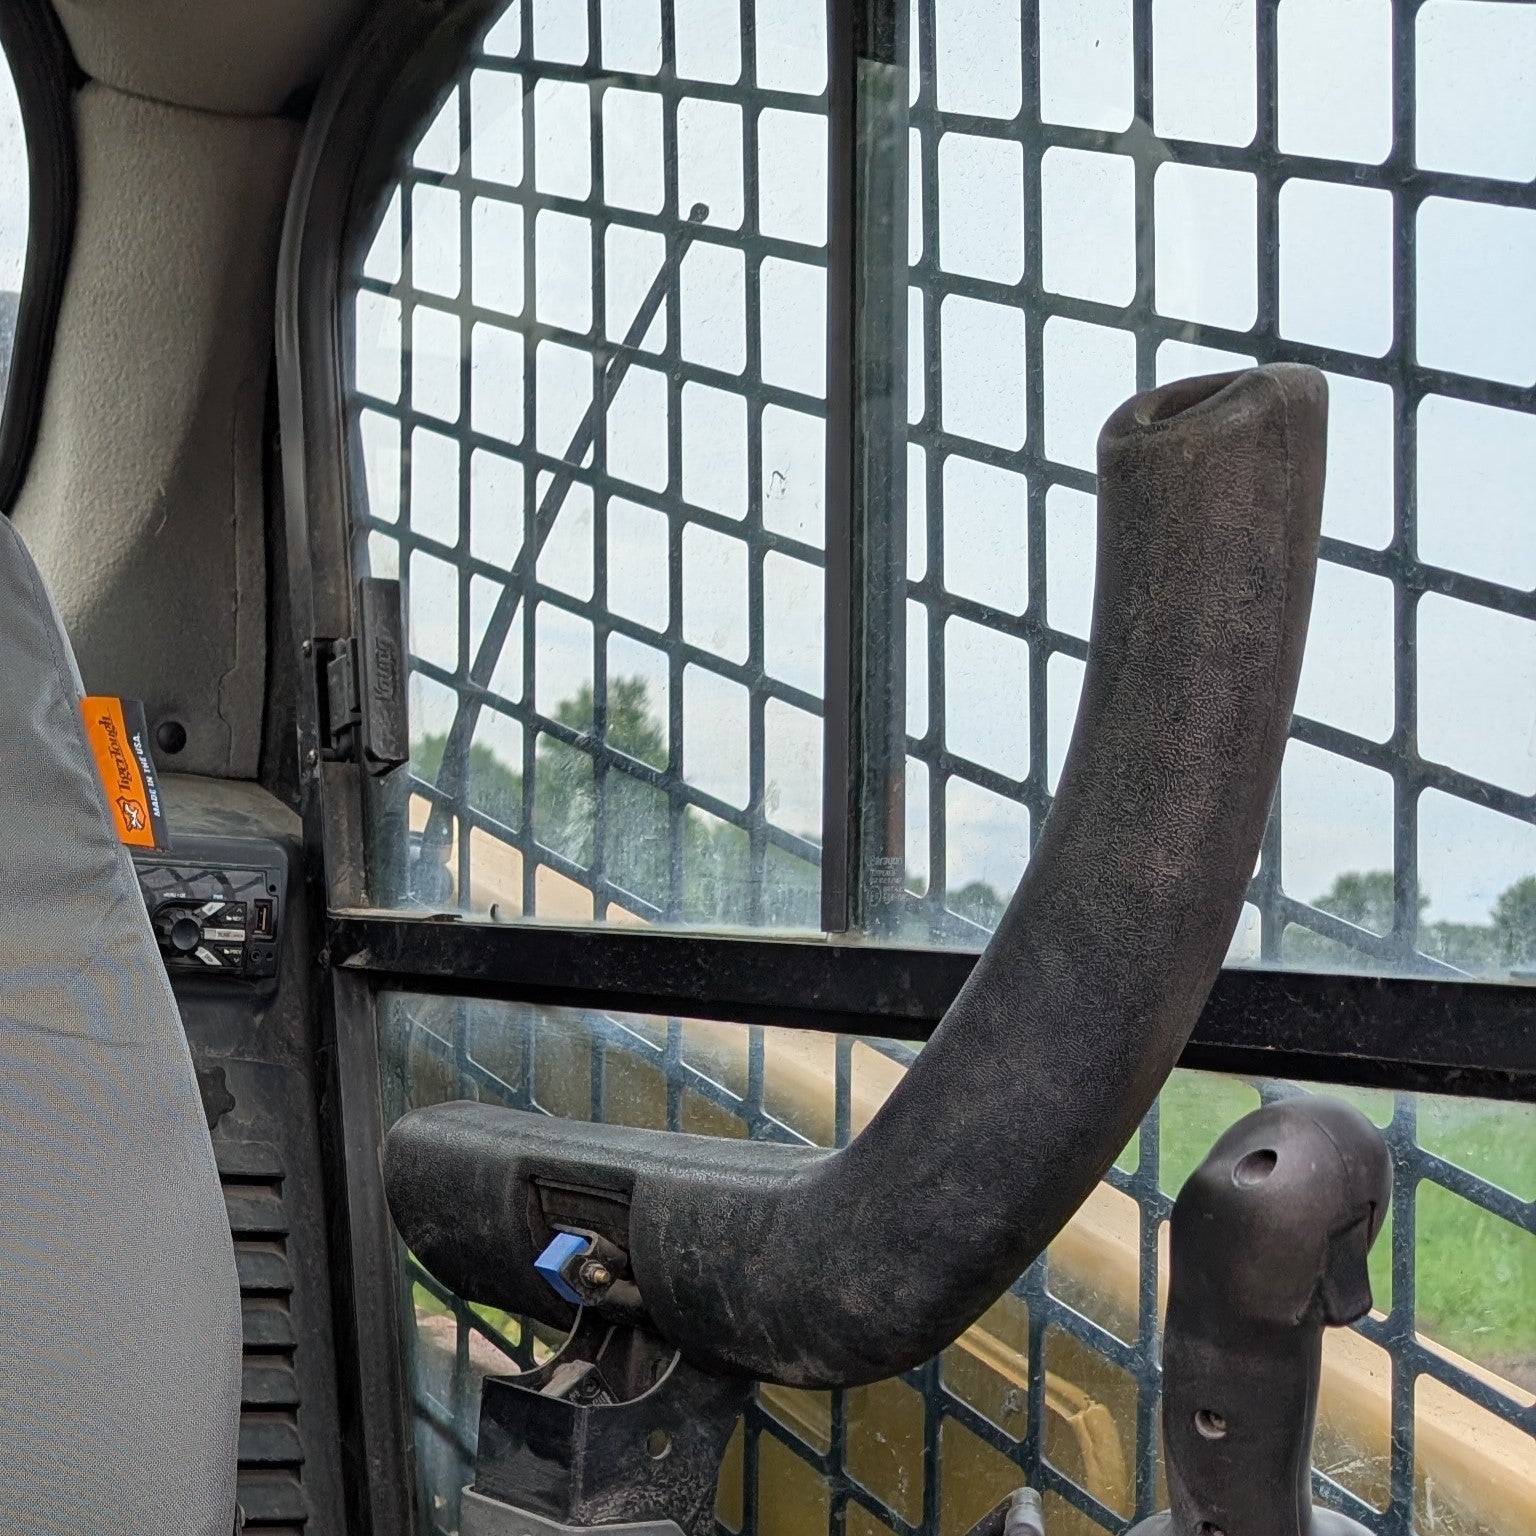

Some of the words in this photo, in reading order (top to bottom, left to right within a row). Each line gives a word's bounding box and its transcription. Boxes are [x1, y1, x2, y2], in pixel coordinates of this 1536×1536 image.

[98, 707, 133, 793] TigerTough
[137, 756, 150, 774] THE
[145, 776, 155, 787] IN
[149, 788, 161, 817] MADE
